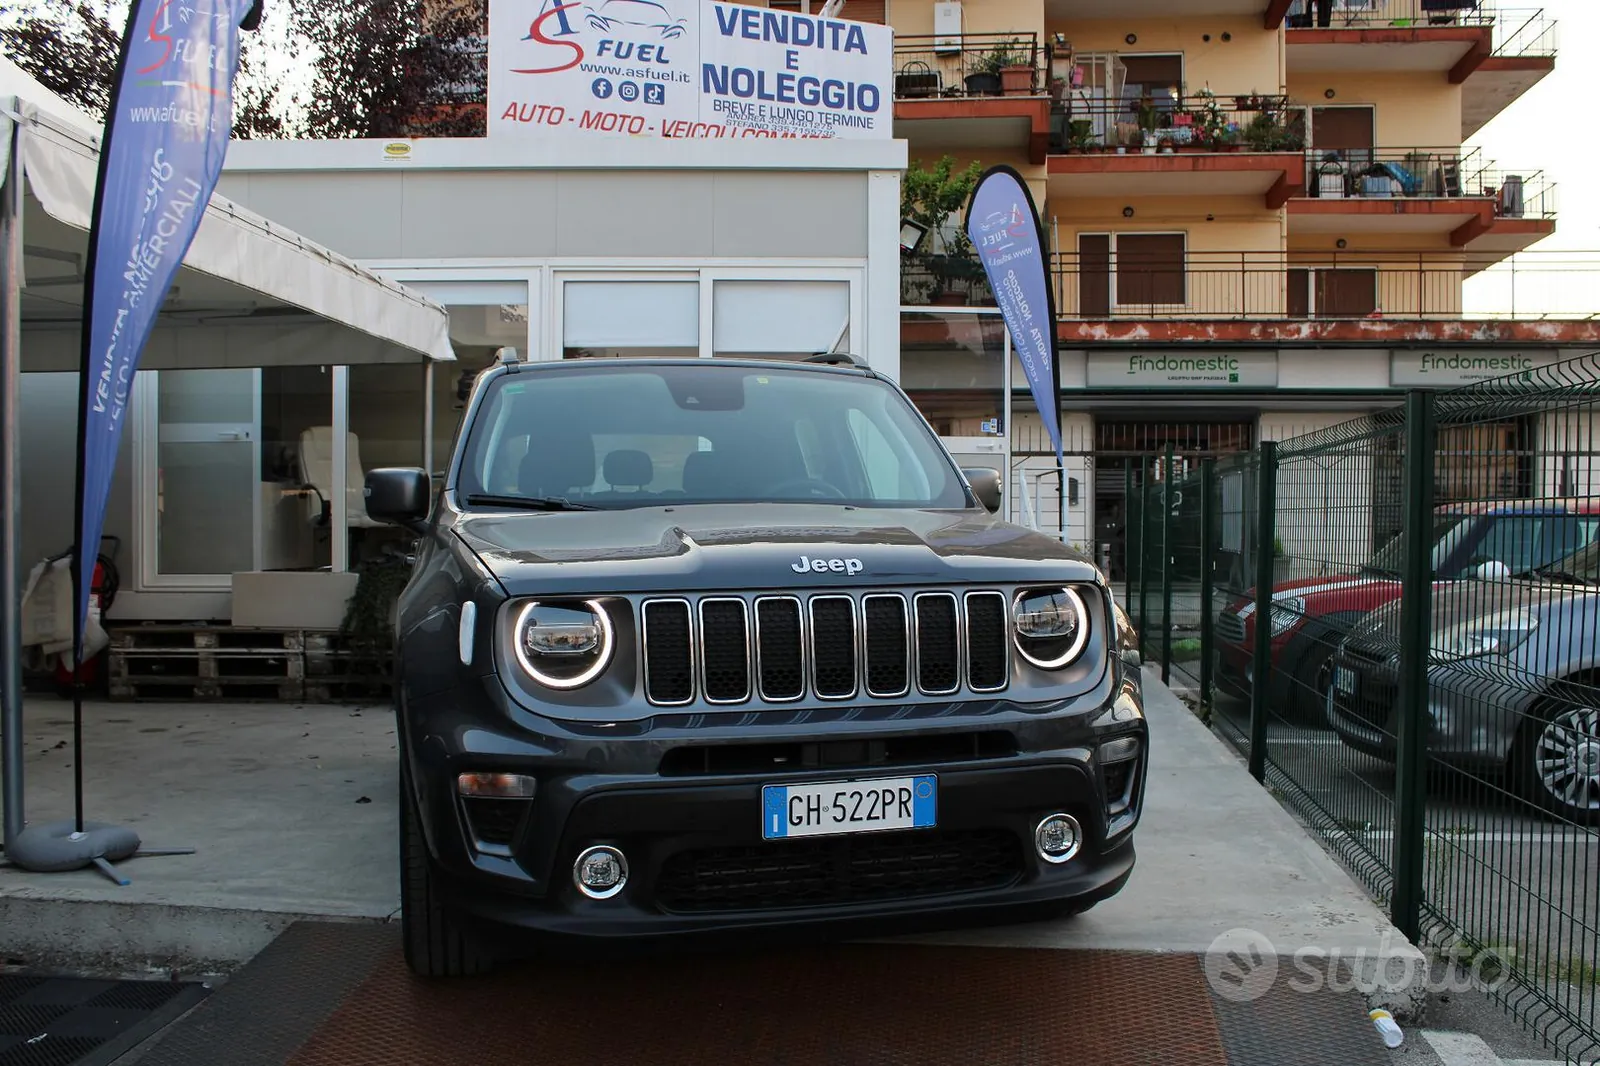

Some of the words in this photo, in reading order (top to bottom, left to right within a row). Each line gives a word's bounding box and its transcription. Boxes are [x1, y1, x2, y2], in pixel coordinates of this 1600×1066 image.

[714, 5, 868, 55] VENDITA
[595, 39, 671, 65] FUEL
[786, 49, 799, 71] E
[580, 62, 691, 84] www.asfuel.it
[702, 63, 880, 113] NOLEGGIO
[501, 102, 565, 126] AUTO
[579, 110, 646, 135] MOTO
[713, 100, 756, 116] BREVE
[759, 104, 767, 117] E
[769, 106, 815, 123] LUNGO
[817, 112, 875, 130] TERMINE
[1127, 355, 1239, 374] findomestic
[1420, 353, 1533, 372] findomestic
[791, 556, 864, 575] Jeep
[788, 794, 822, 826] GH
[832, 787, 913, 823] 522PR
